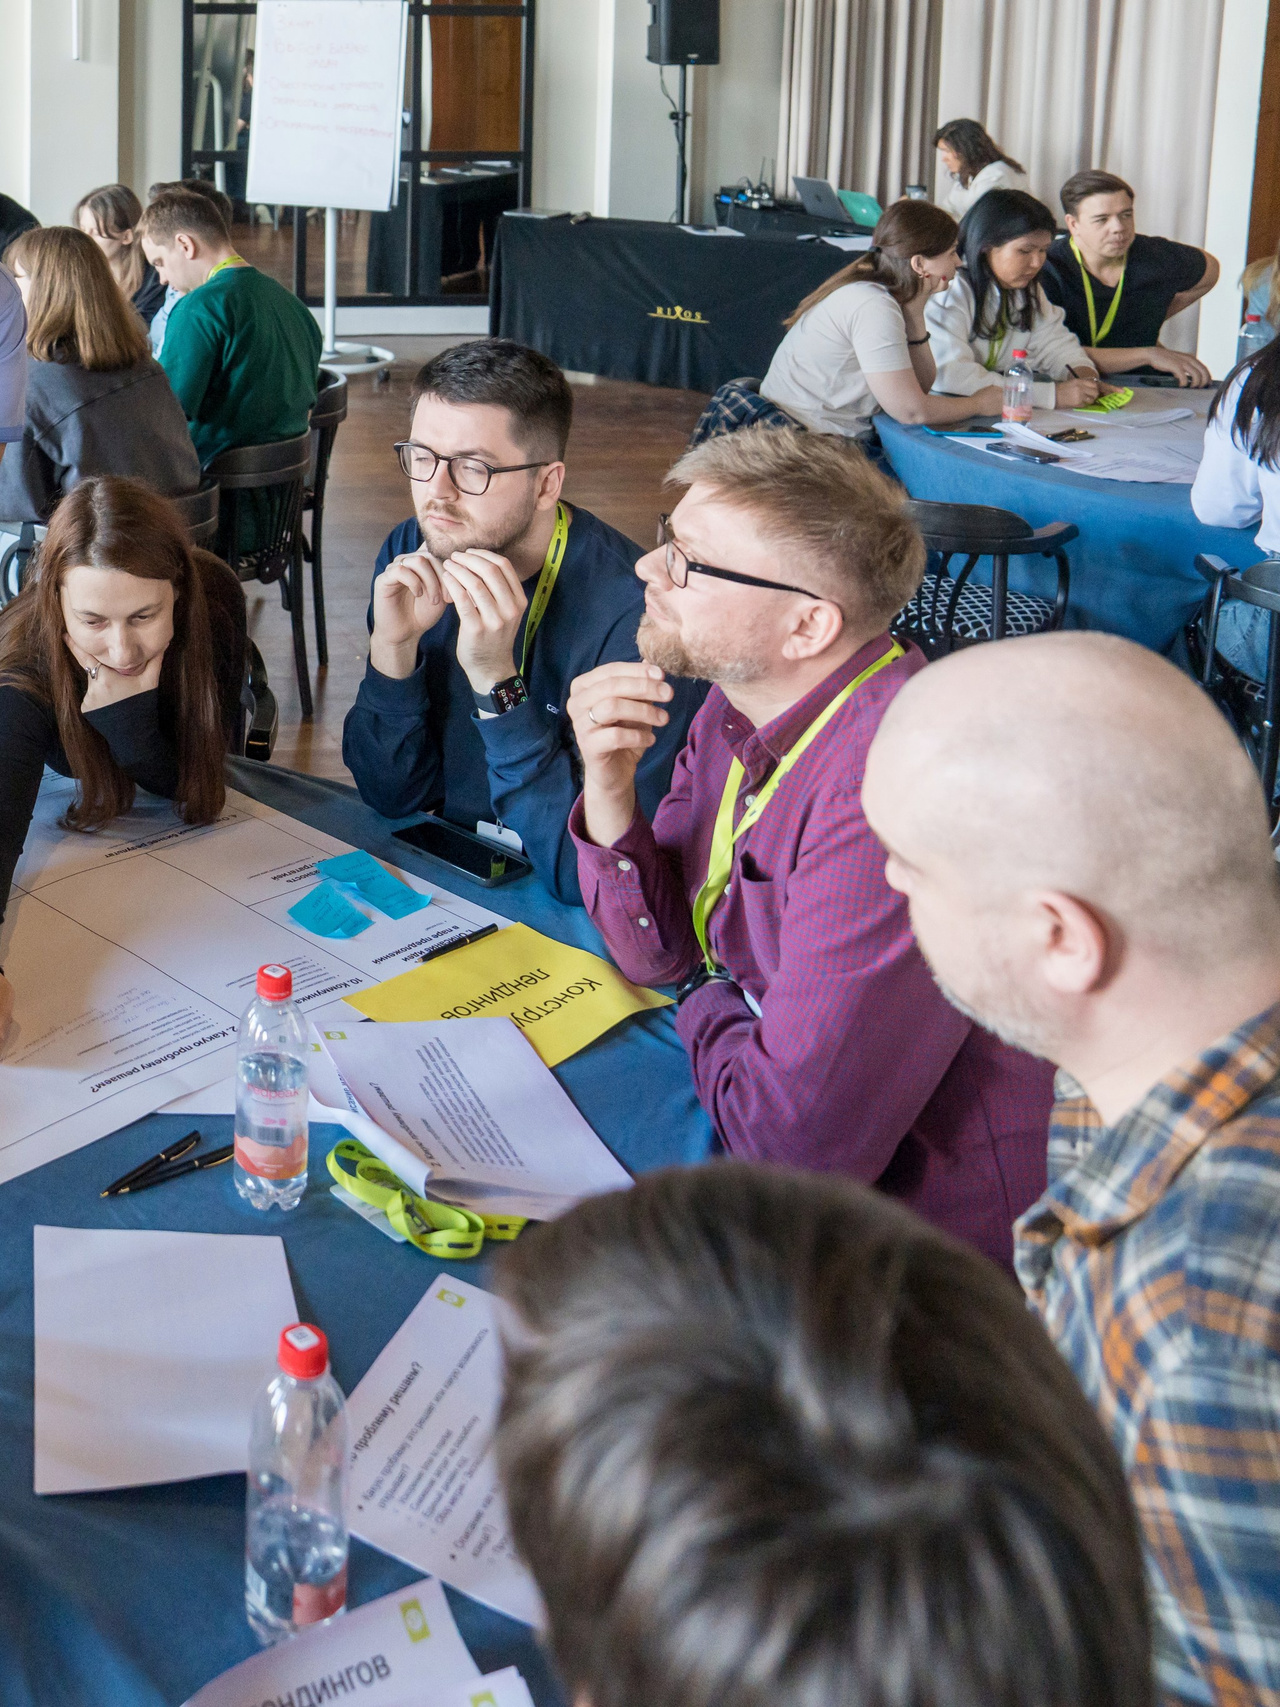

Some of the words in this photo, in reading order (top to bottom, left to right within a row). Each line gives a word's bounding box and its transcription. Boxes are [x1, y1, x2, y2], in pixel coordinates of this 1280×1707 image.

[430, 927, 452, 938] паре
[371, 936, 431, 964] предложений
[189, 1029, 229, 1048] Какую
[224, 1025, 240, 1033] 2.
[137, 1043, 196, 1070] проблему
[85, 1066, 143, 1093] решаем?
[350, 1401, 396, 1453] проблему
[385, 1359, 426, 1405] решаем?
